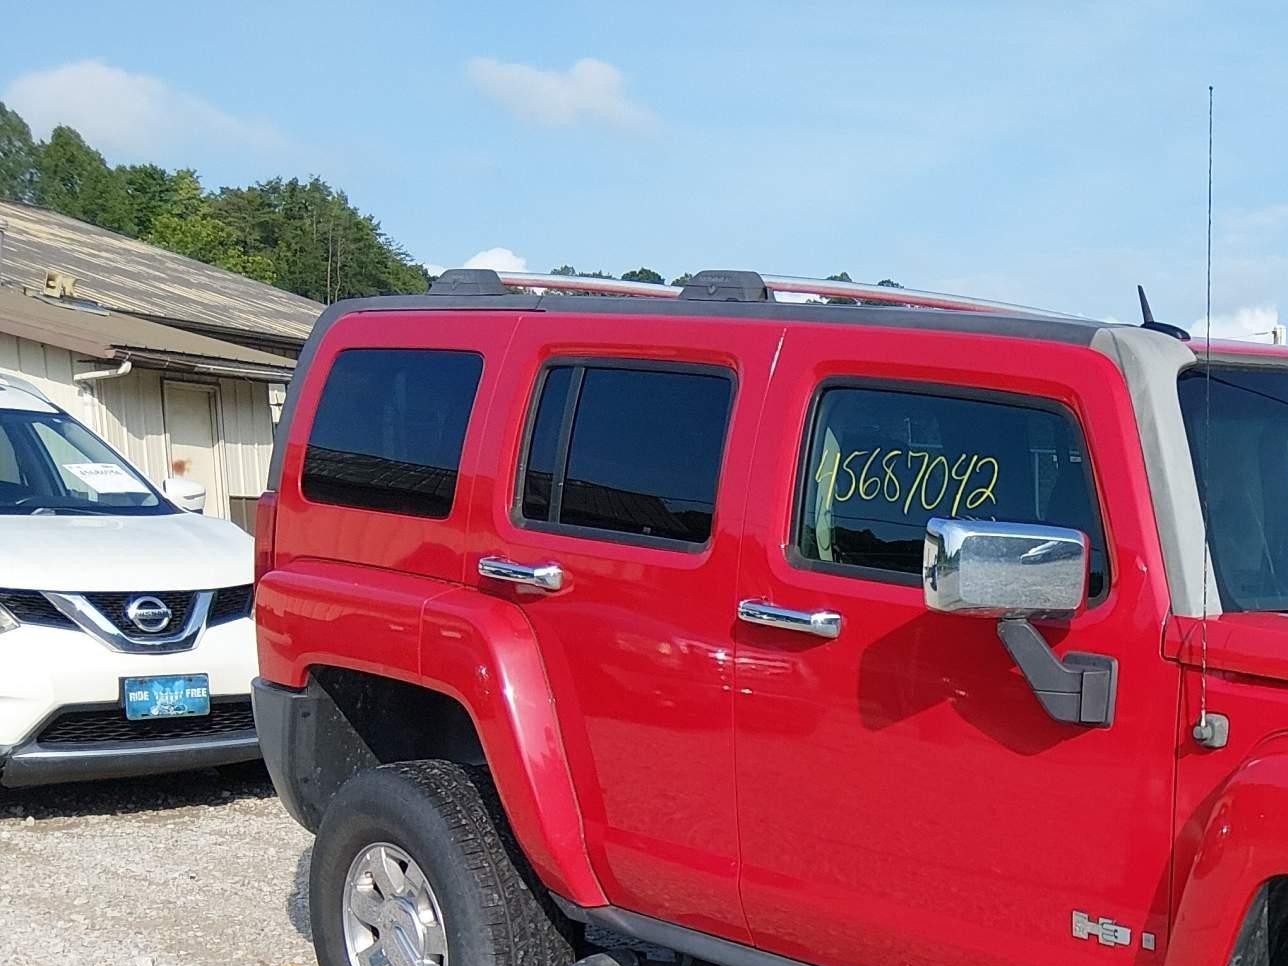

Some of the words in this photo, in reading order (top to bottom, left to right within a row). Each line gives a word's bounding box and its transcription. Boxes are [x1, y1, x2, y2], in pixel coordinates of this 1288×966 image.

[815, 447, 999, 517] 45687042
[129, 691, 149, 702] RIDE
[186, 687, 208, 698] FREE
